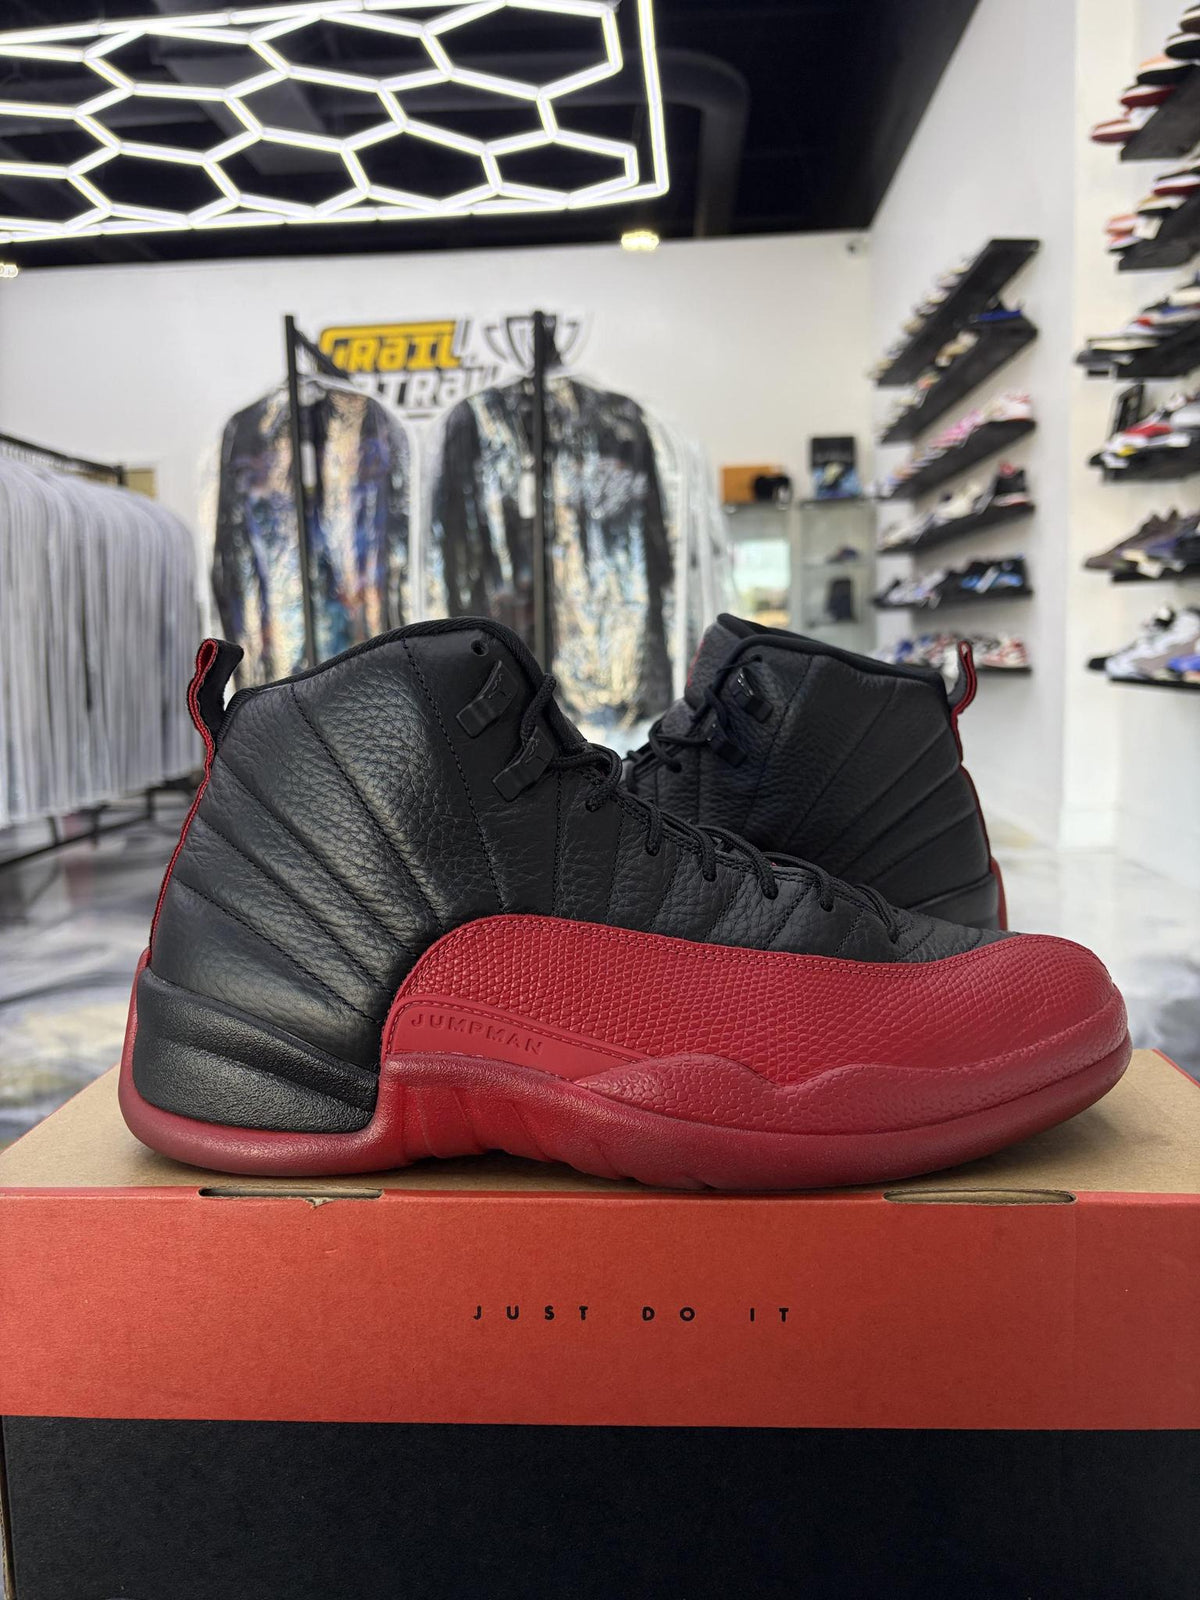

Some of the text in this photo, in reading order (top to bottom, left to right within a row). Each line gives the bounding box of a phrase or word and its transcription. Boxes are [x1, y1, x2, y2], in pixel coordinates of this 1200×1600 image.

[410, 1013, 543, 1055] JUMPMAN
[473, 1305, 789, 1322] JUST DO IT
